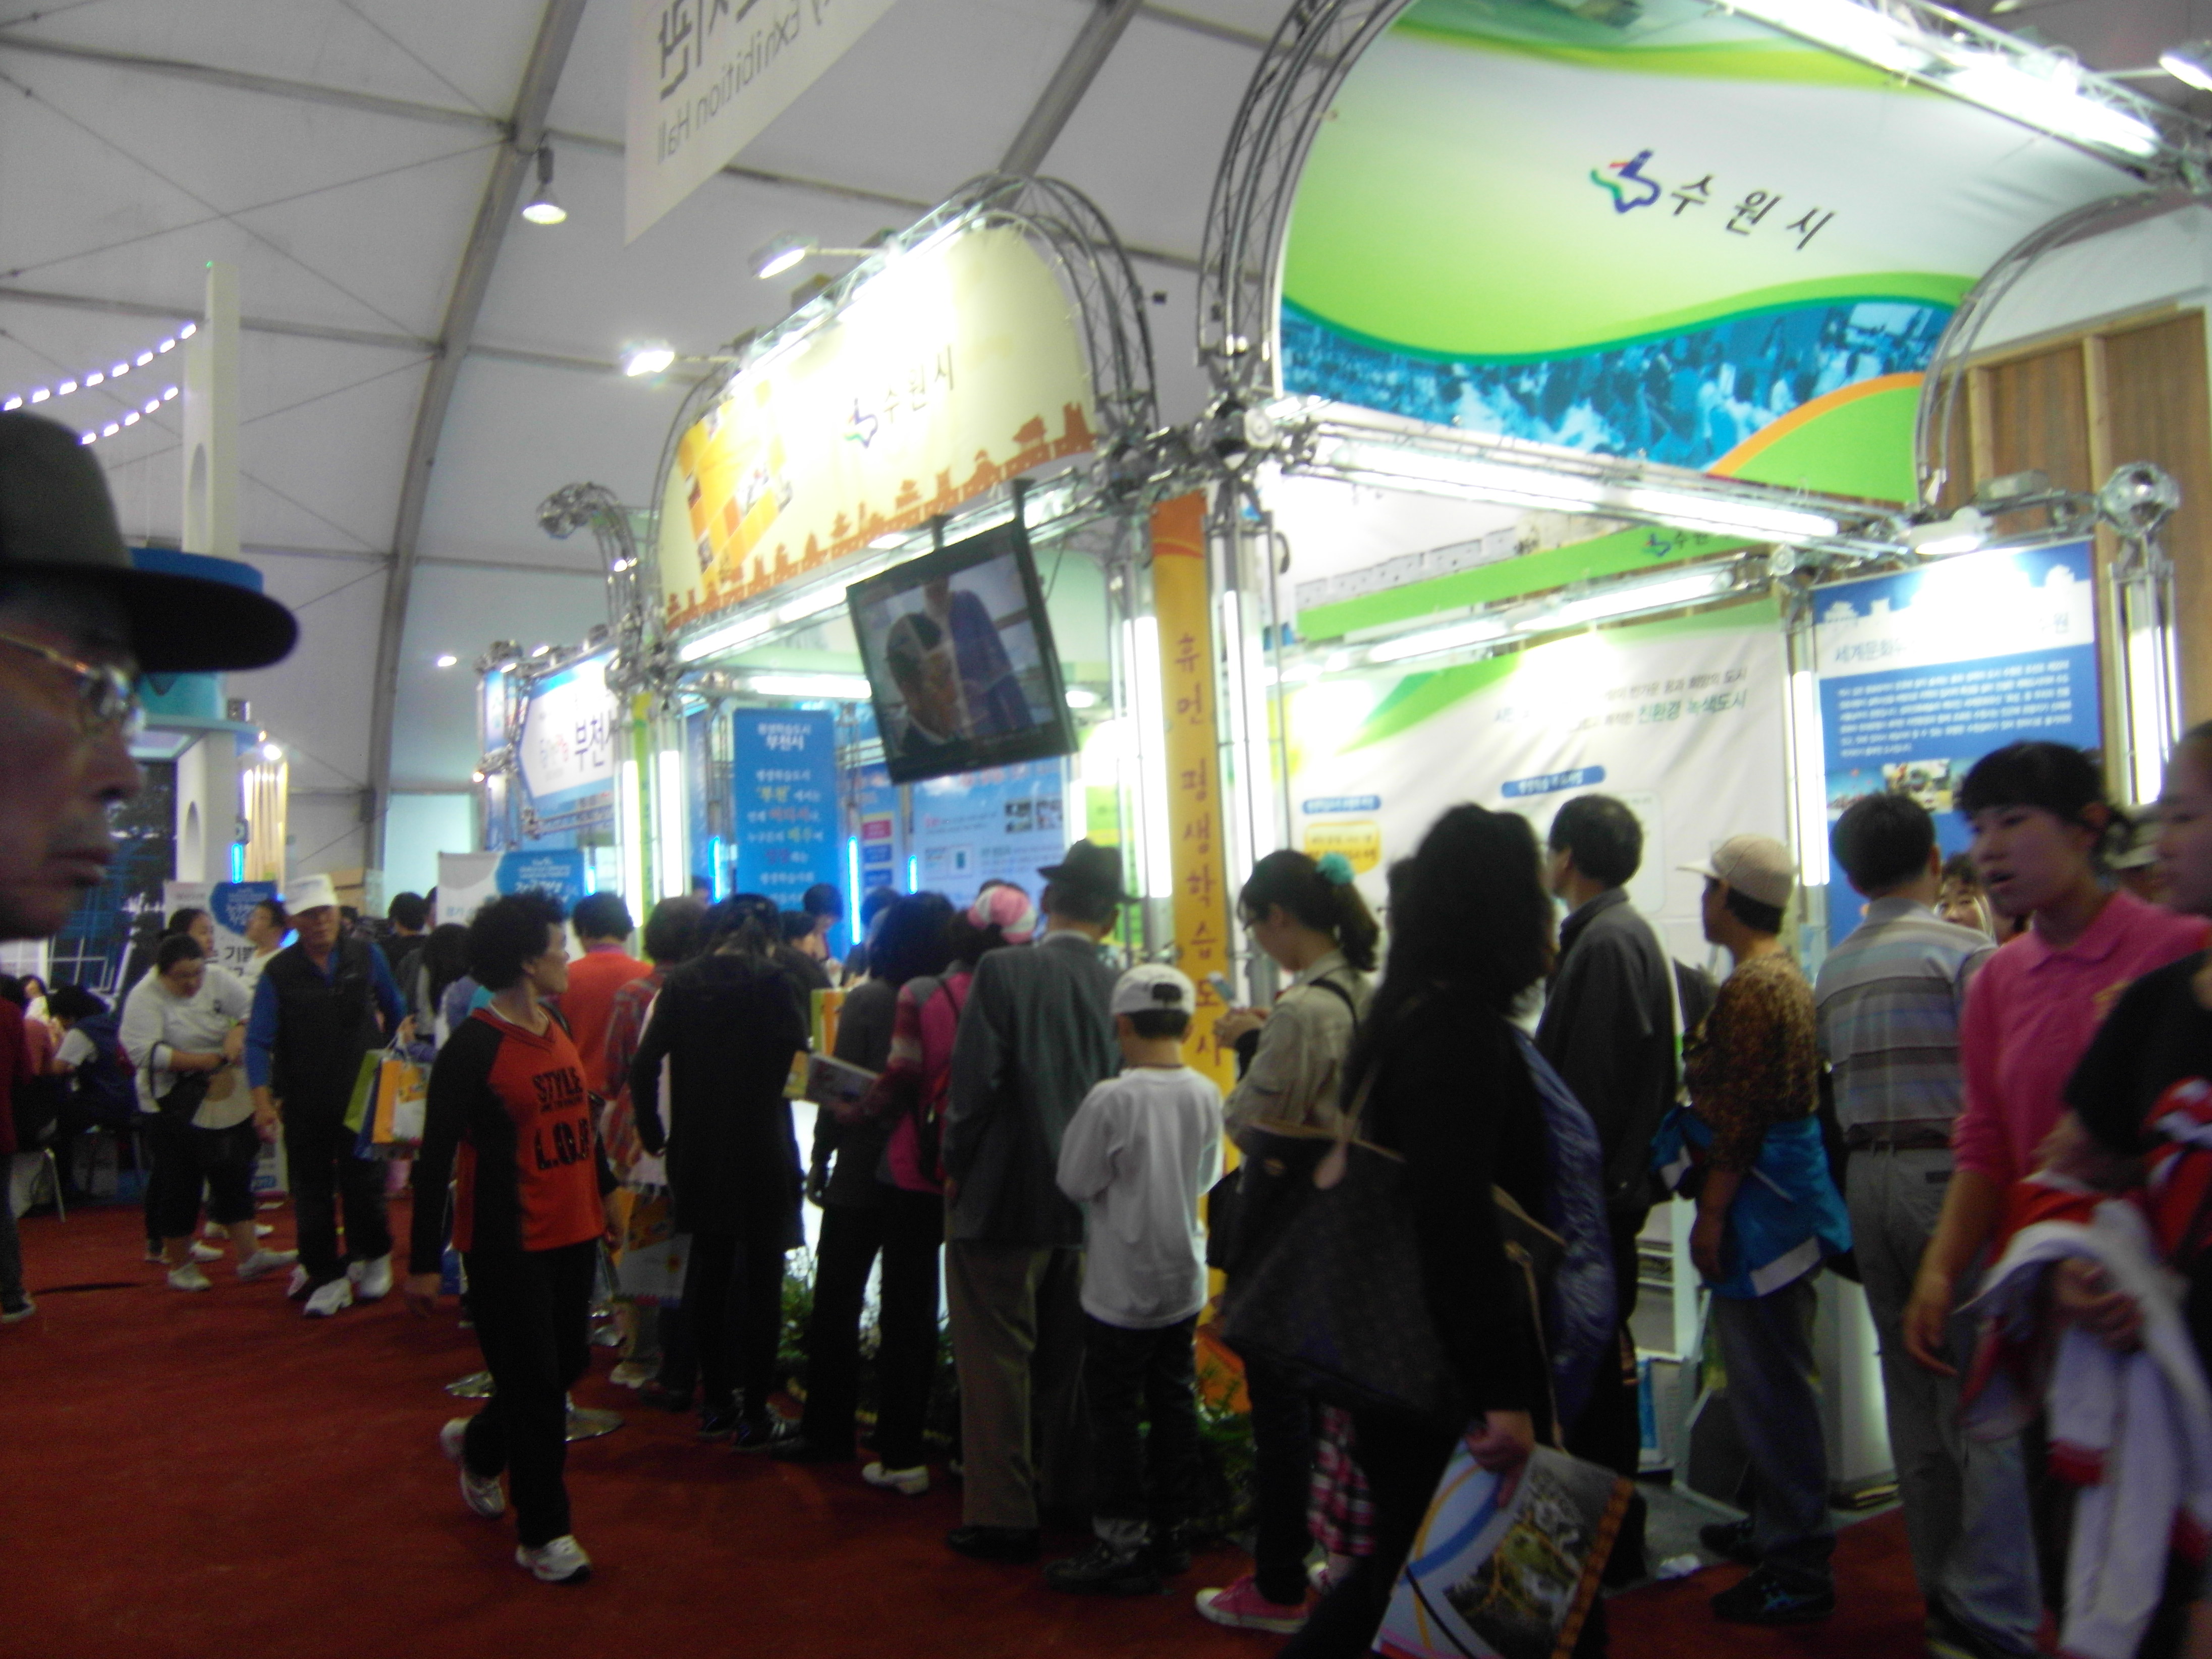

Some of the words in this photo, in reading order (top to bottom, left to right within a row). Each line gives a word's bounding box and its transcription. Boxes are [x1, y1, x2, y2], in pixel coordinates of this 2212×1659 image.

[1671, 174, 1836, 251] 수원시
[883, 345, 954, 423] 수원시
[575, 711, 614, 772] 부천
